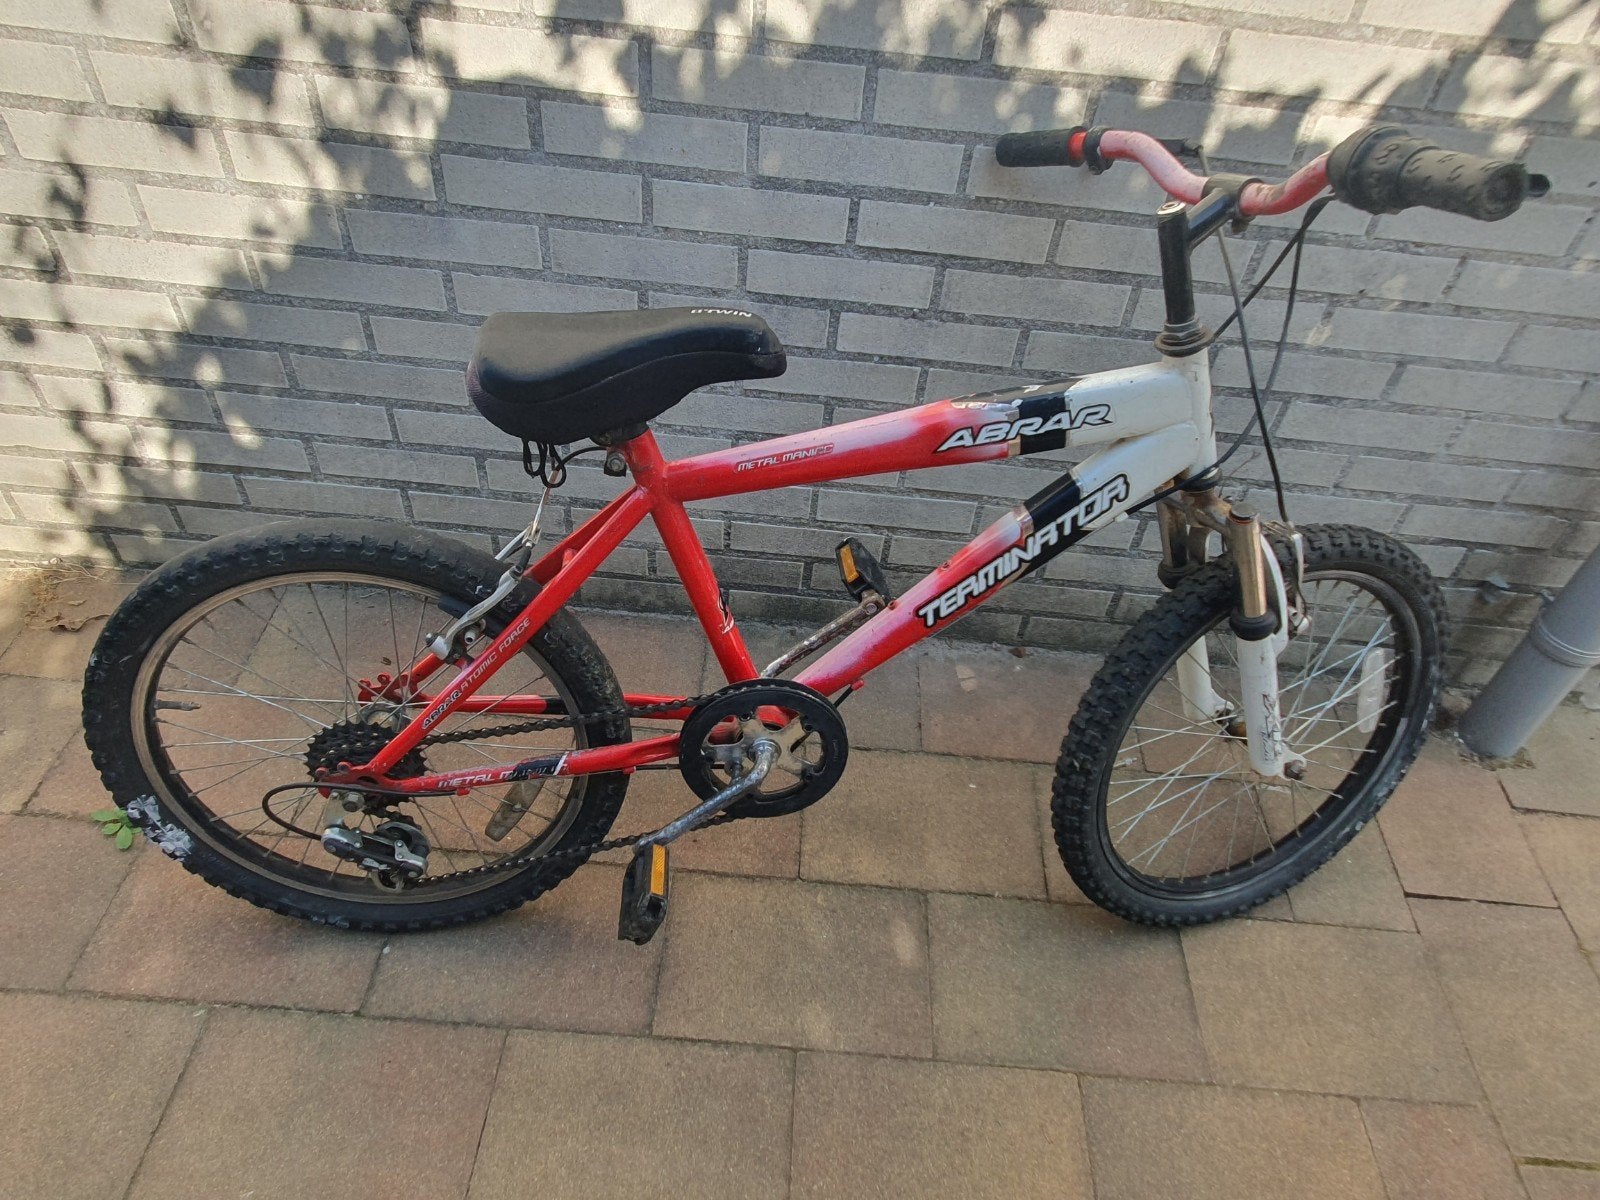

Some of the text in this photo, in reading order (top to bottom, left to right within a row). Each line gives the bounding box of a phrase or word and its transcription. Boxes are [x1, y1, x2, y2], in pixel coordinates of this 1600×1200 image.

[935, 403, 1113, 453] ABRAR
[737, 456, 780, 472] METAL
[460, 651, 498, 692] ATOMIC
[498, 617, 530, 653] FORCE
[437, 772, 495, 789] METAL
